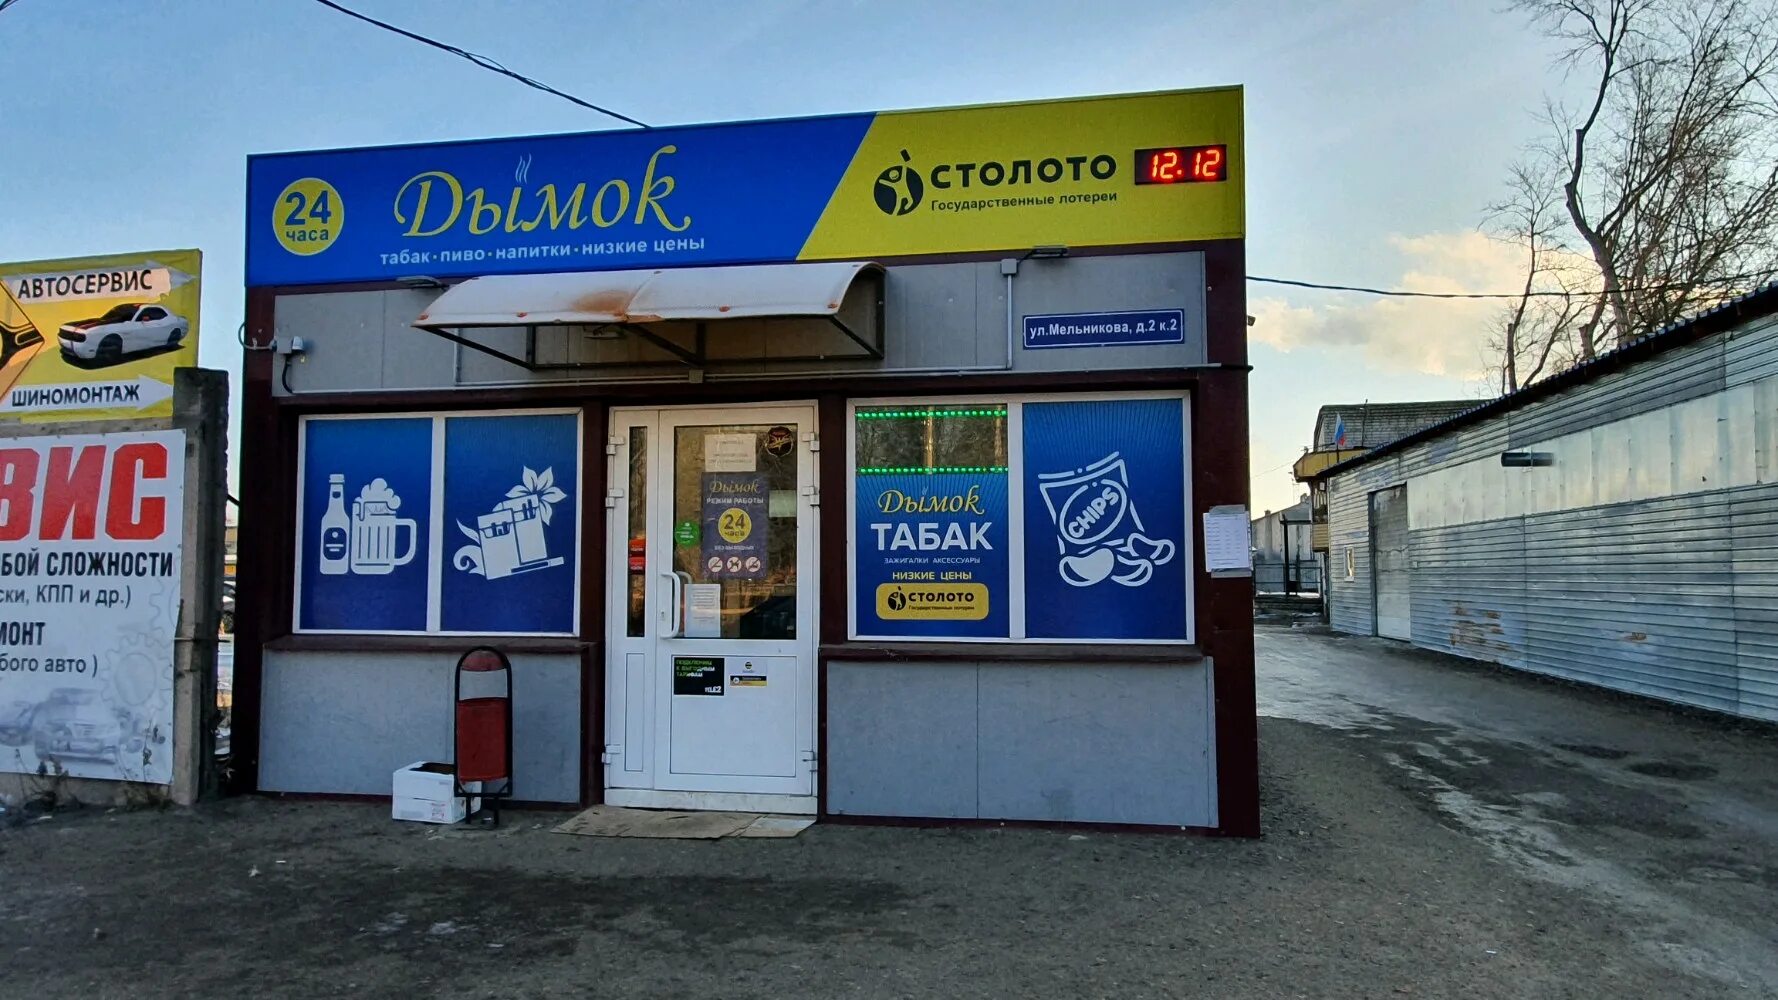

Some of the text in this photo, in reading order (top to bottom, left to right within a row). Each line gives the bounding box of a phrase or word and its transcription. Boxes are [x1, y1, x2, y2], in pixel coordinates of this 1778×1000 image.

[930, 154, 1117, 190] СТОЛОТО
[394, 145, 691, 237] Дымок
[285, 190, 332, 226] 24
[931, 192, 1117, 212] Государственные лотереи
[286, 229, 329, 242] часа
[653, 237, 705, 254] цены
[17, 269, 153, 299] АВТОСЕРВИС
[1135, 319, 1156, 334] д.2
[1159, 318, 1178, 332] к.2
[12, 384, 141, 407] ШИНОМОНТАЖ
[724, 514, 745, 530] 24
[1068, 487, 1119, 538] CHIPS
[871, 522, 994, 551] ТАБАК
[1, 547, 174, 577] БОЙ СЛОЖНОСТИ
[884, 557, 981, 565] ЗАЖИГАЛКИ АКСЕССУАРЫ
[892, 571, 973, 582] НИЗКИЕ ЦЕНЫ
[36, 584, 74, 603] КПП
[79, 589, 91, 603] и
[908, 592, 975, 603] СТОЛОТО
[0, 652, 39, 672] бого
[44, 658, 87, 673] авто
